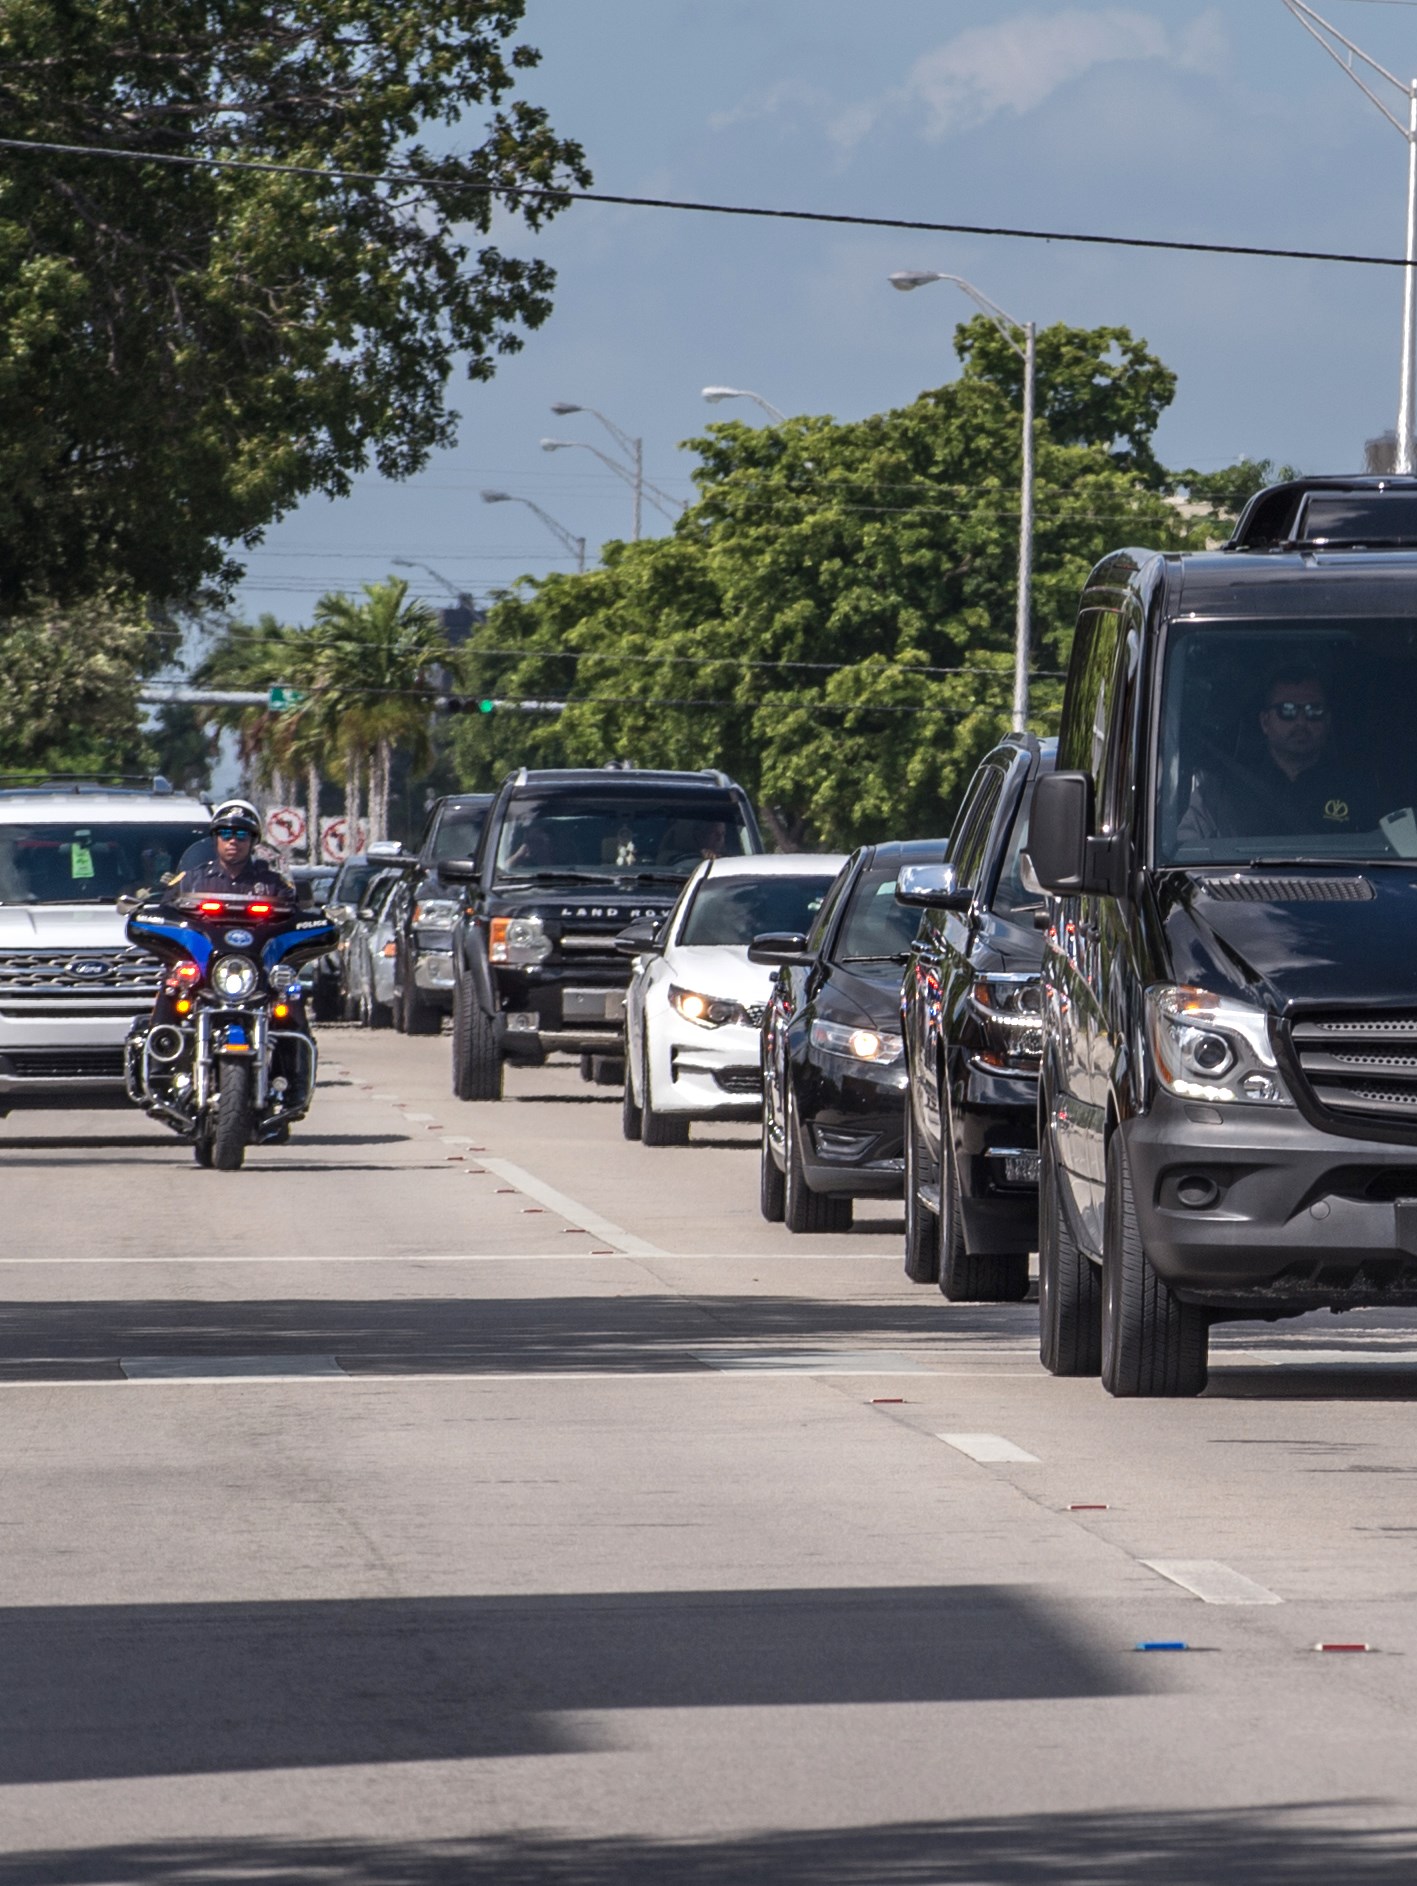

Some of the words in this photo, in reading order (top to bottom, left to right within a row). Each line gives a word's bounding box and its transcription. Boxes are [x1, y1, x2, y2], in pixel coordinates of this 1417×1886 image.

[561, 907, 619, 917] LAND
[630, 909, 671, 918] ROV
[295, 919, 328, 930] POLICE
